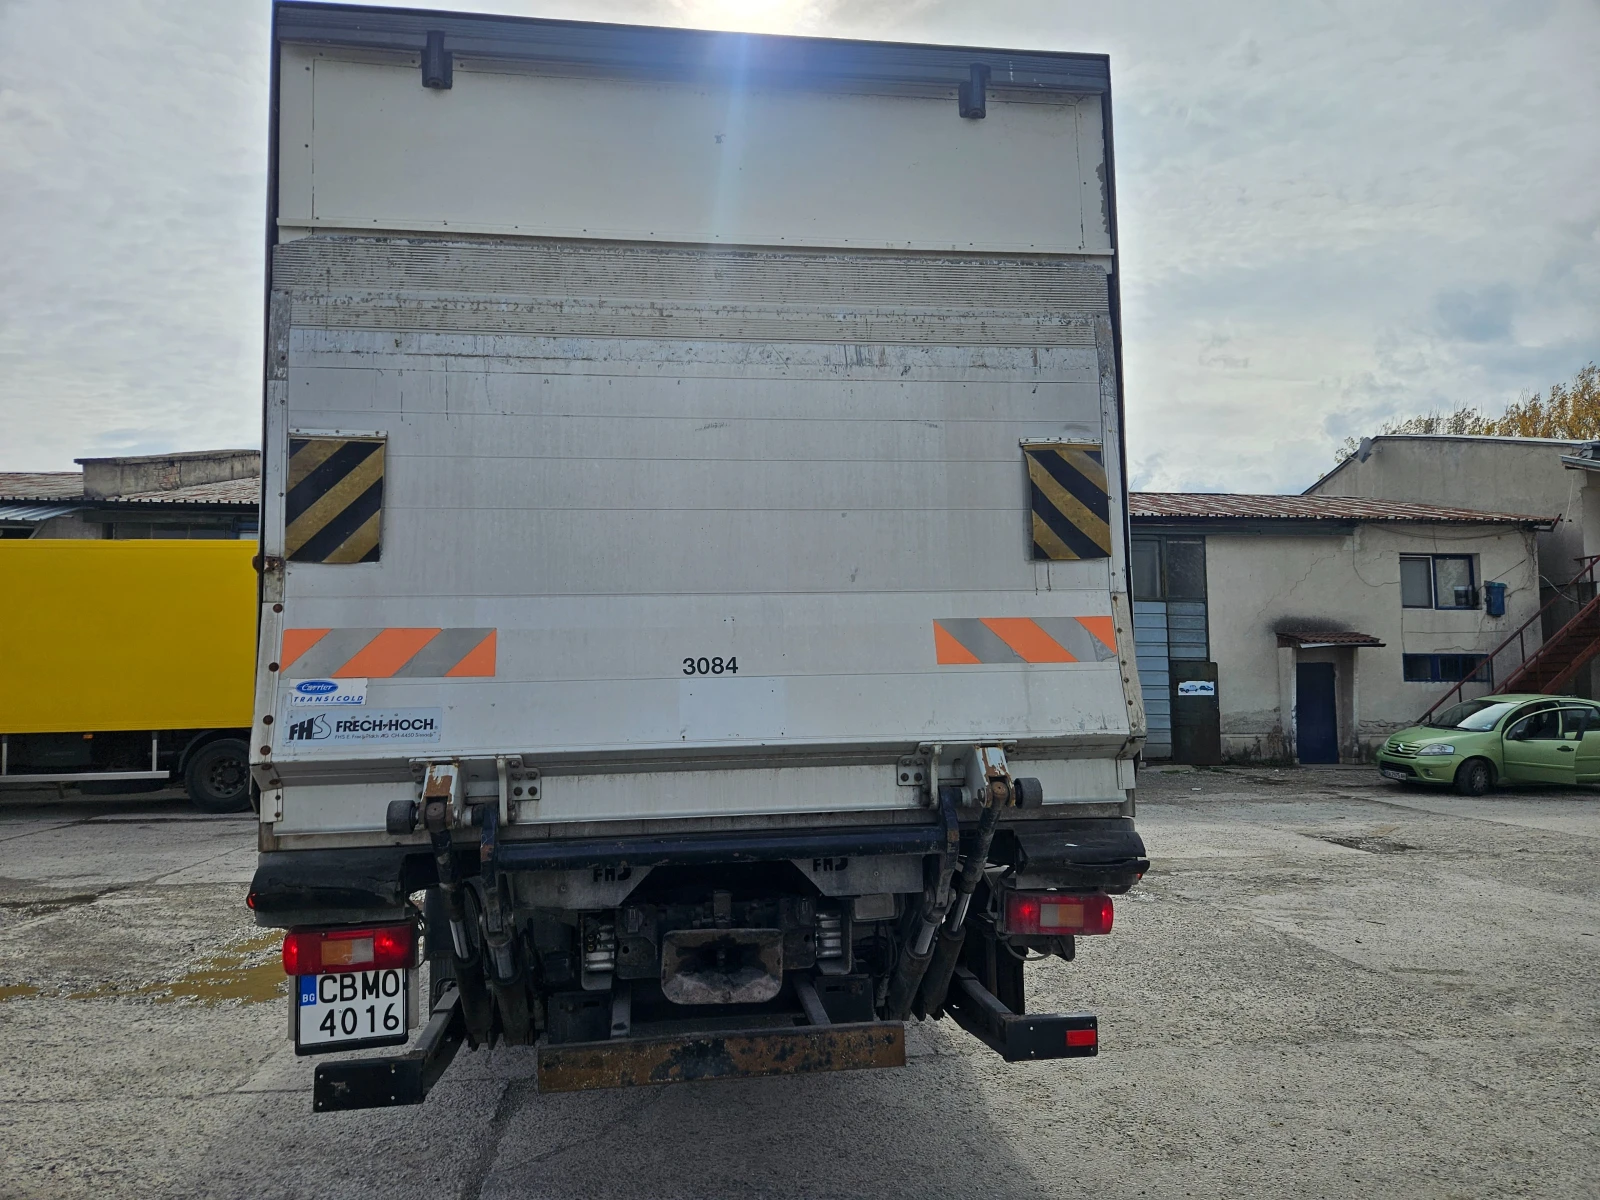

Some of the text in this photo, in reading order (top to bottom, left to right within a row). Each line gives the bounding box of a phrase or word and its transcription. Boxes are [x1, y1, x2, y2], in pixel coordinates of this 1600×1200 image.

[682, 656, 738, 675] 3084
[301, 683, 333, 692] Carrier
[294, 695, 364, 703] TRANSICOLD
[289, 713, 332, 741] FHS
[319, 969, 400, 1003] CBMO
[302, 993, 315, 1003] BG
[320, 1003, 400, 1037] 4016
